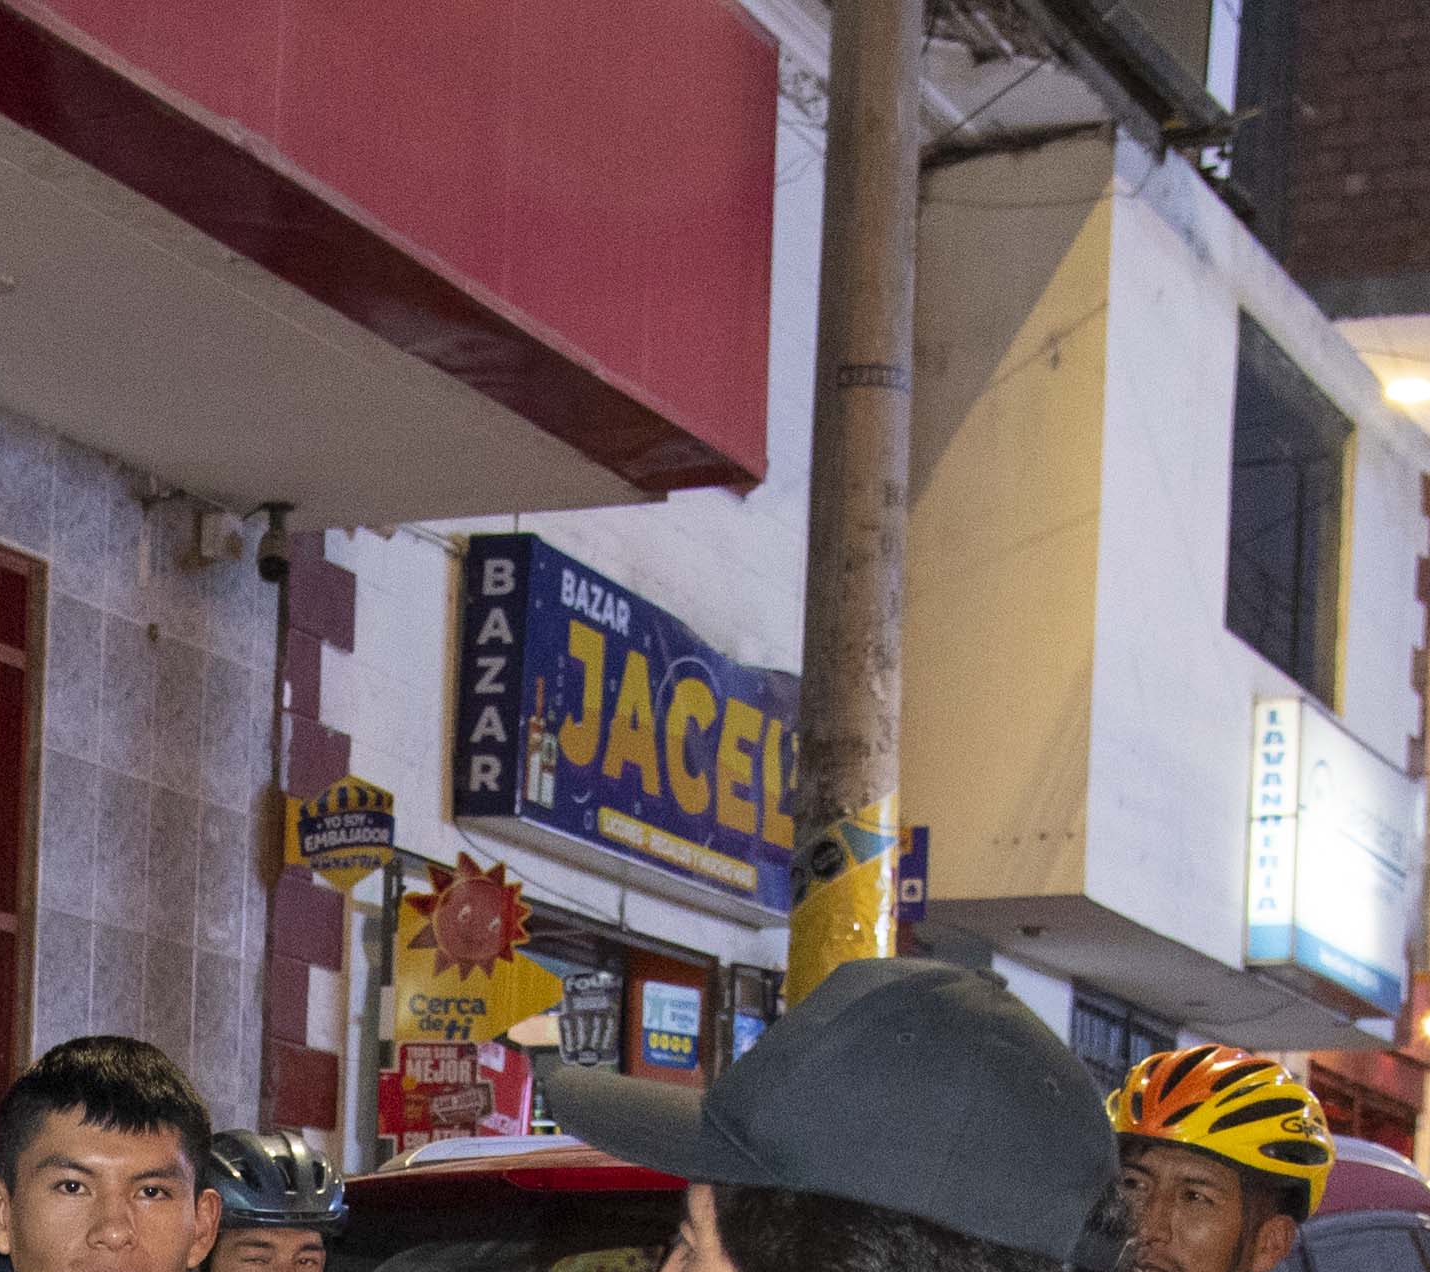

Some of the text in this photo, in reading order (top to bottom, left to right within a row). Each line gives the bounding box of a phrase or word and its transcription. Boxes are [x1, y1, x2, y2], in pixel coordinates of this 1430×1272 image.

[561, 568, 631, 638] BAZAR
[470, 557, 516, 794] BAZAR
[558, 619, 799, 849] JACEL
[409, 994, 486, 1015] Cerca
[419, 1015, 473, 1040] de ti
